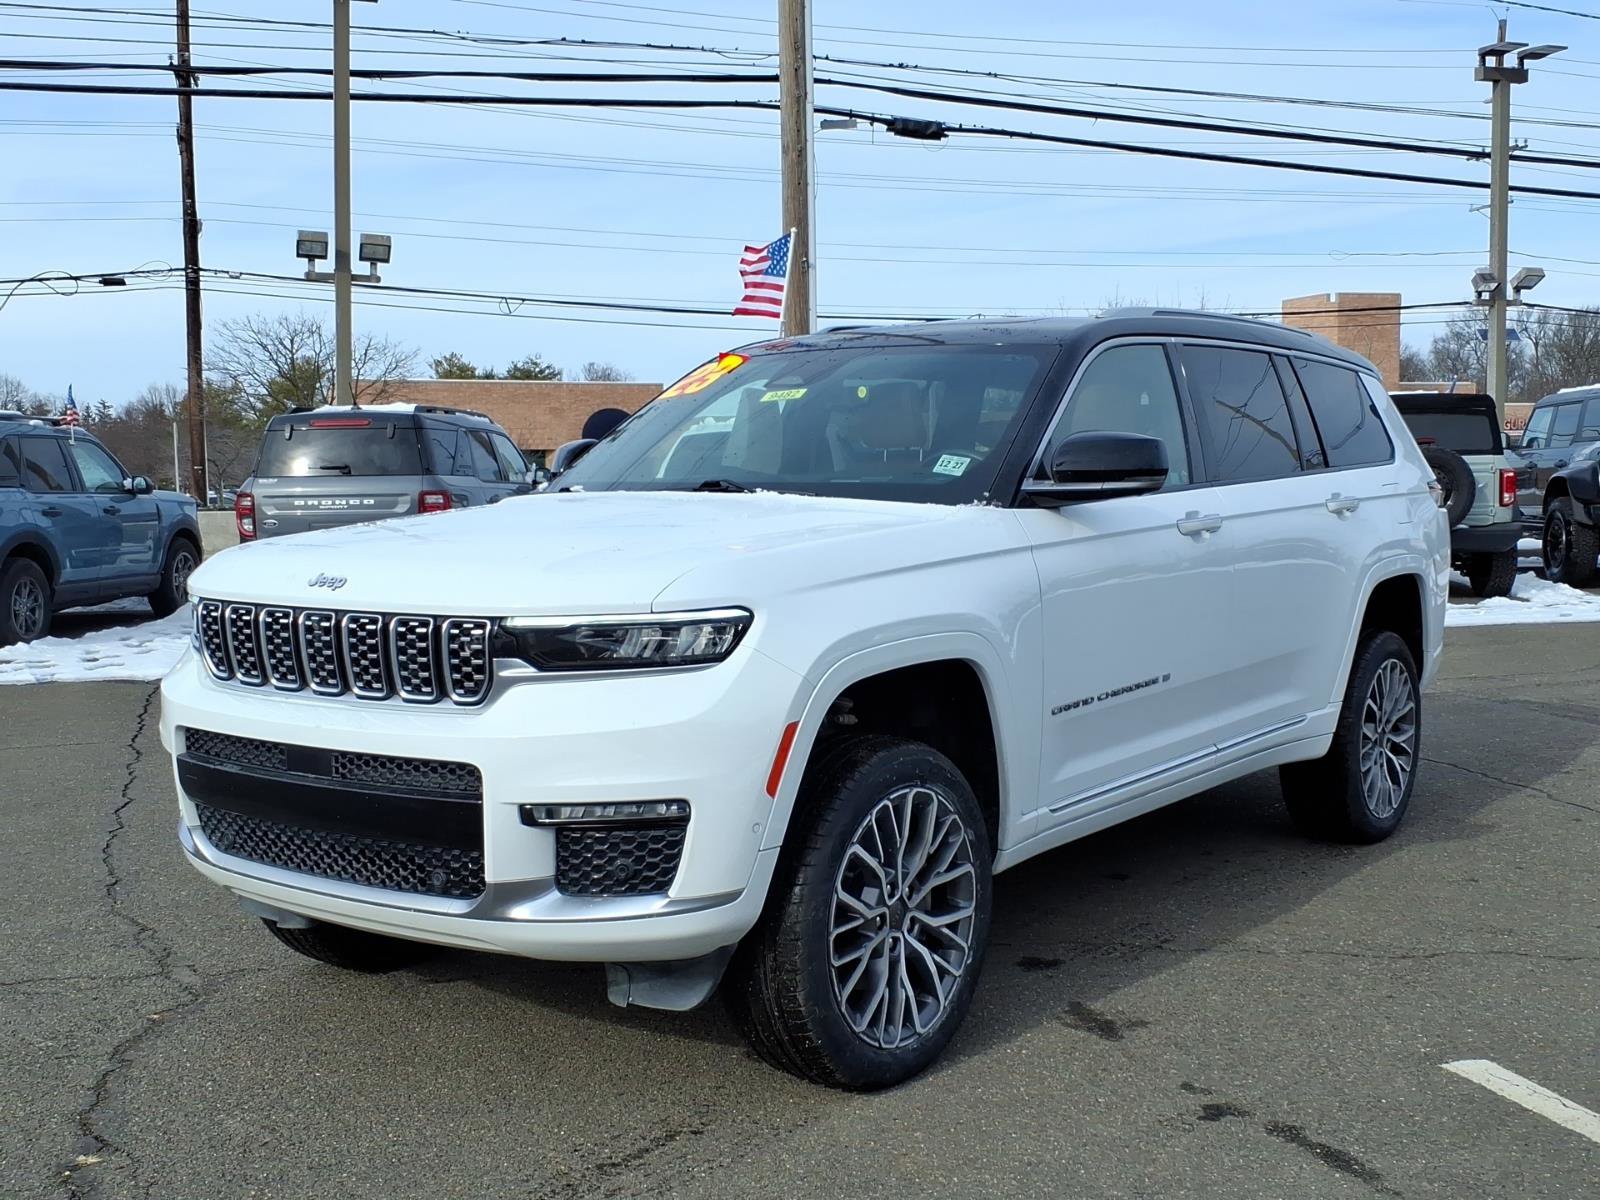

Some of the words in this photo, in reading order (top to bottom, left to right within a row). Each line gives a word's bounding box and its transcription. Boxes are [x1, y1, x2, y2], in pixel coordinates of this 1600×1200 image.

[1504, 417, 1527, 430] GUR
[938, 459, 951, 468] 12
[307, 572, 348, 592] Jeep
[1051, 696, 1095, 716] GRAND
[1097, 676, 1160, 702] CHEROKEE
